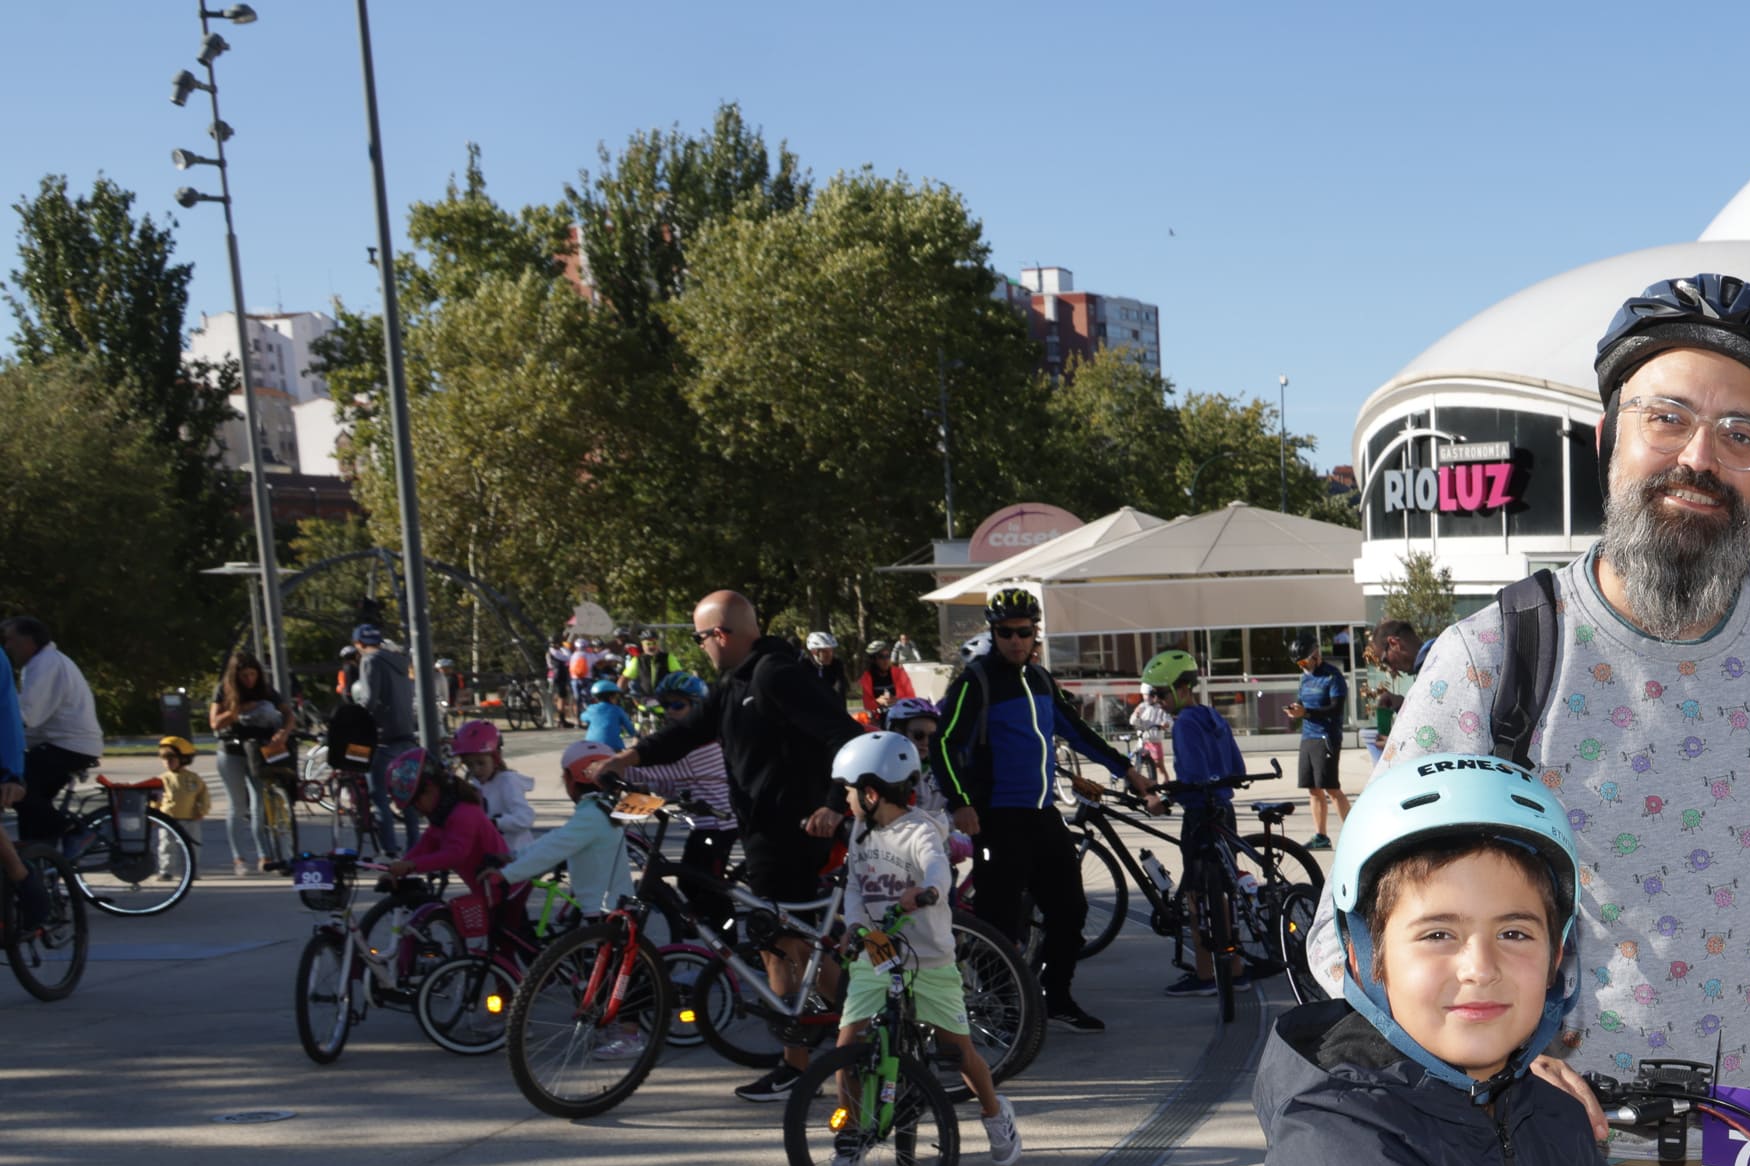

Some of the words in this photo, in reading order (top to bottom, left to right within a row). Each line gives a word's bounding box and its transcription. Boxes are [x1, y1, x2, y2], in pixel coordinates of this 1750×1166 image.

[1440, 445, 1507, 459] GASTRONOMÍA
[1417, 759, 1533, 783] ERNEST
[302, 871, 322, 884] 90
